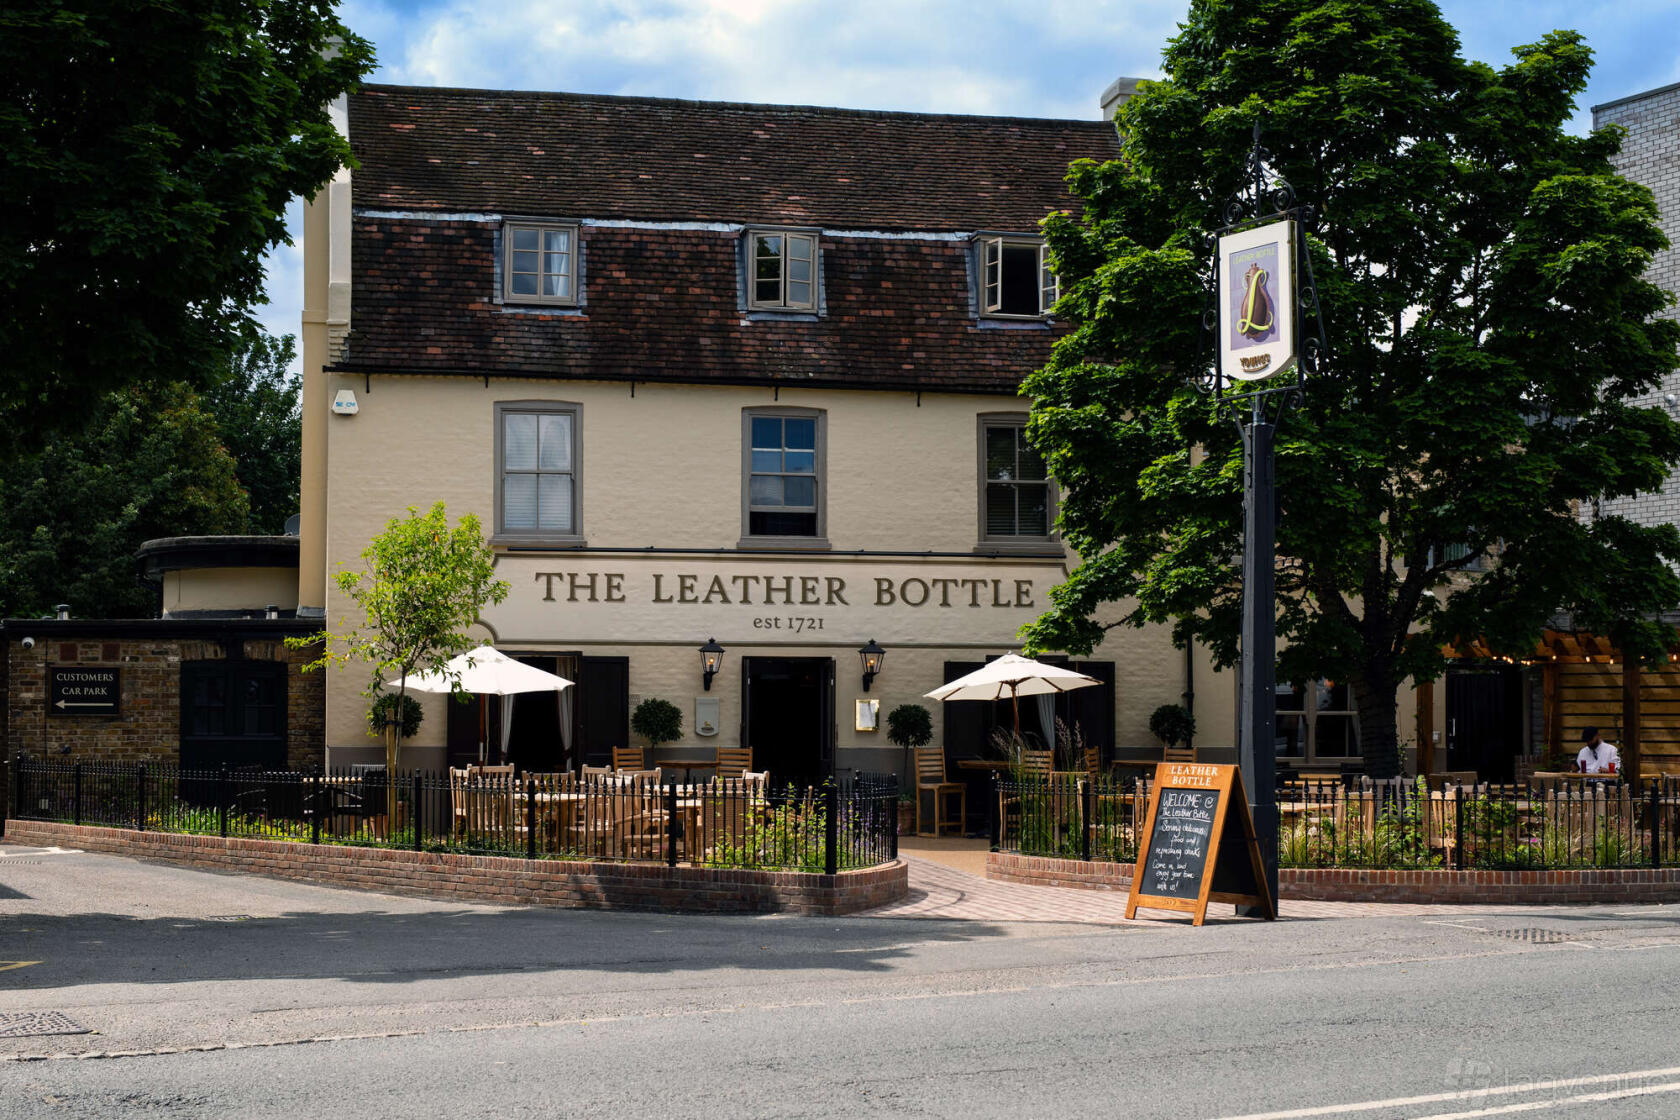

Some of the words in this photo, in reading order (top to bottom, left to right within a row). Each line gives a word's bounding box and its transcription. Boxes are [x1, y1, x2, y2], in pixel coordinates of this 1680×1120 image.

[535, 572, 626, 602] THE
[652, 573, 850, 607] LEATHER
[874, 577, 1036, 608] BOTTLE
[753, 617, 782, 630] est
[788, 617, 825, 634] 1721
[56, 672, 114, 681] CUSTOMERS
[61, 687, 81, 695] CAR
[83, 687, 108, 696] PARK
[1170, 765, 1218, 777] LEATHER
[1172, 775, 1212, 786] BOTTLE
[1163, 792, 1202, 808] WELCOME
[1161, 819, 1182, 839] Serving
[1171, 834, 1185, 848] food
[1152, 859, 1166, 869] Come
